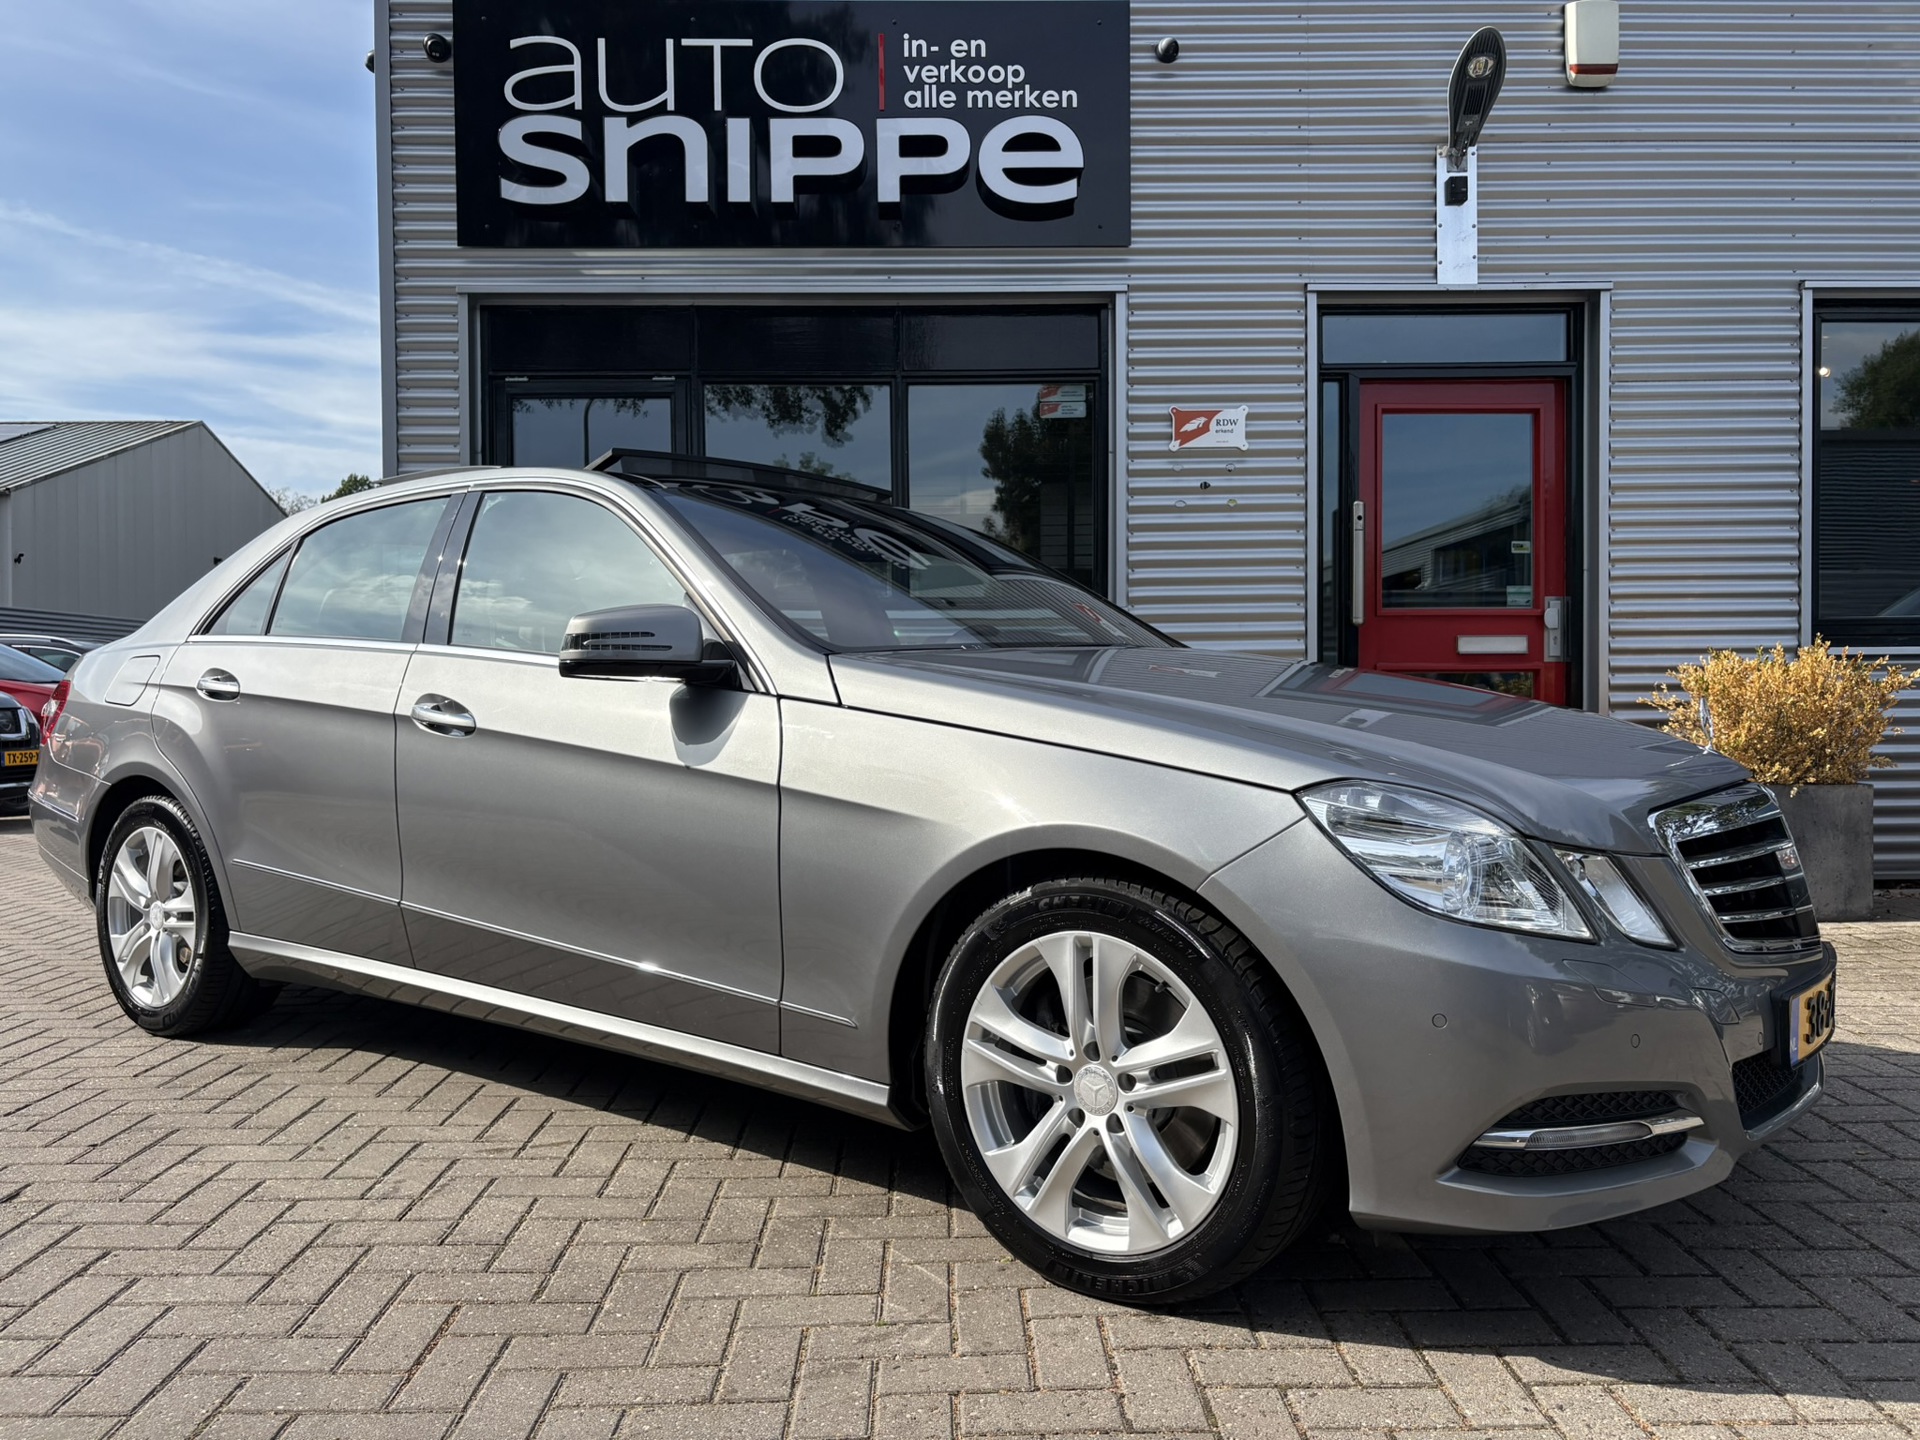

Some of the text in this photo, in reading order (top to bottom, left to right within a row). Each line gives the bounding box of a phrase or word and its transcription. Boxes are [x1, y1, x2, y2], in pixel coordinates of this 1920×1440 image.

[903, 33, 986, 58] in- en
[903, 59, 1025, 89] verkoop
[903, 84, 1078, 109] alle merken
[1215, 418, 1239, 427] RDW
